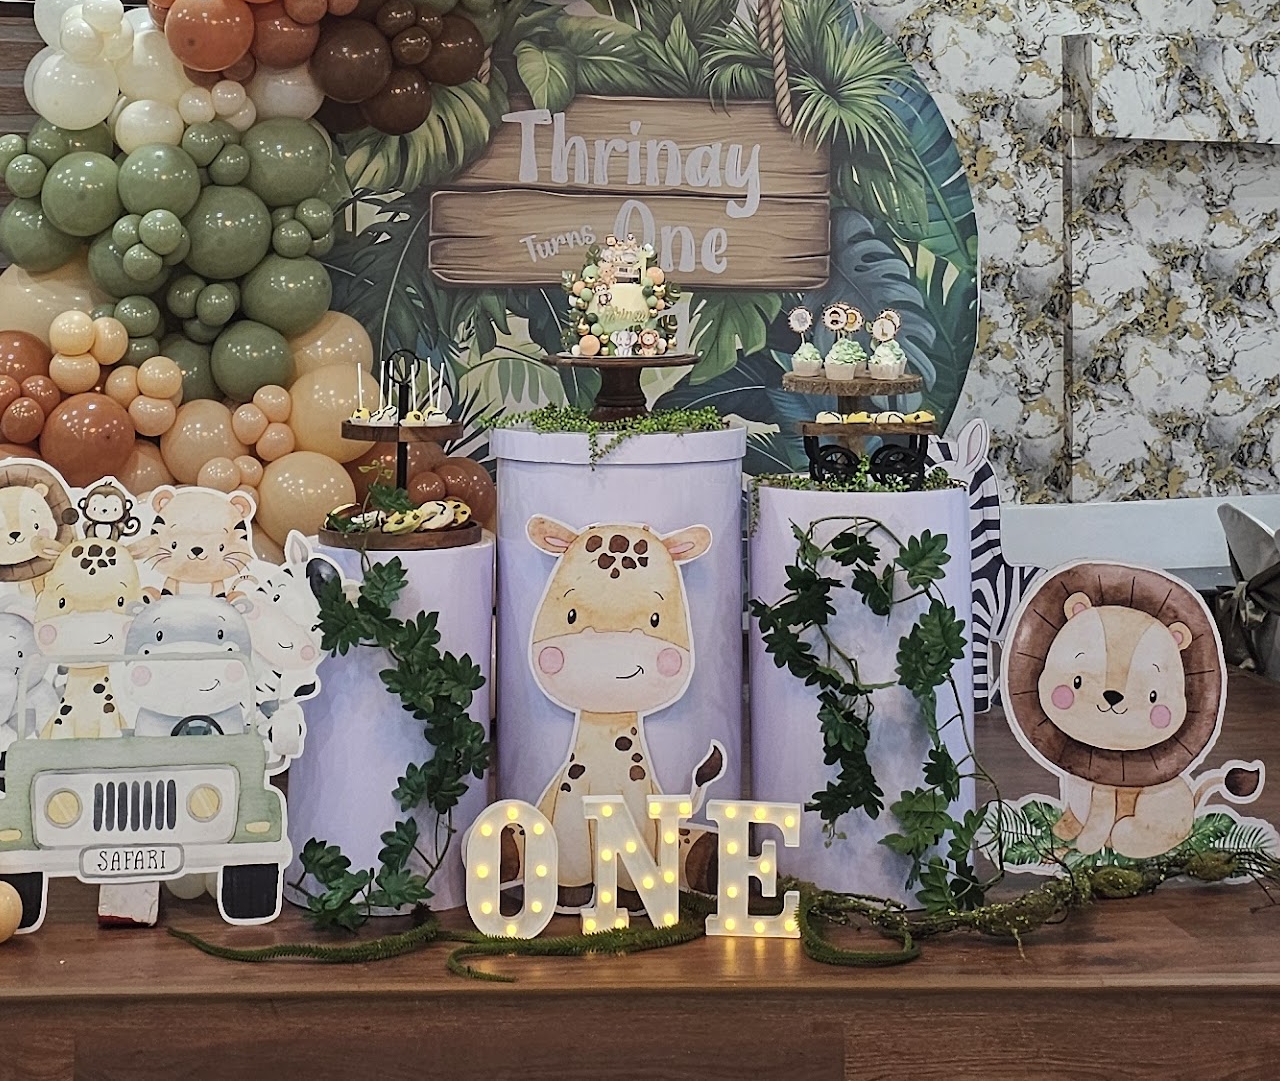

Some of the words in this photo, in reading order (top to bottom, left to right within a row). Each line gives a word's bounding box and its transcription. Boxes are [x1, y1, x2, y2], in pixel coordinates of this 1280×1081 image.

[502, 109, 761, 218] Thrinay
[519, 225, 596, 262] Turns
[97, 849, 166, 872] SAFARI
[466, 794, 801, 940] ONE
